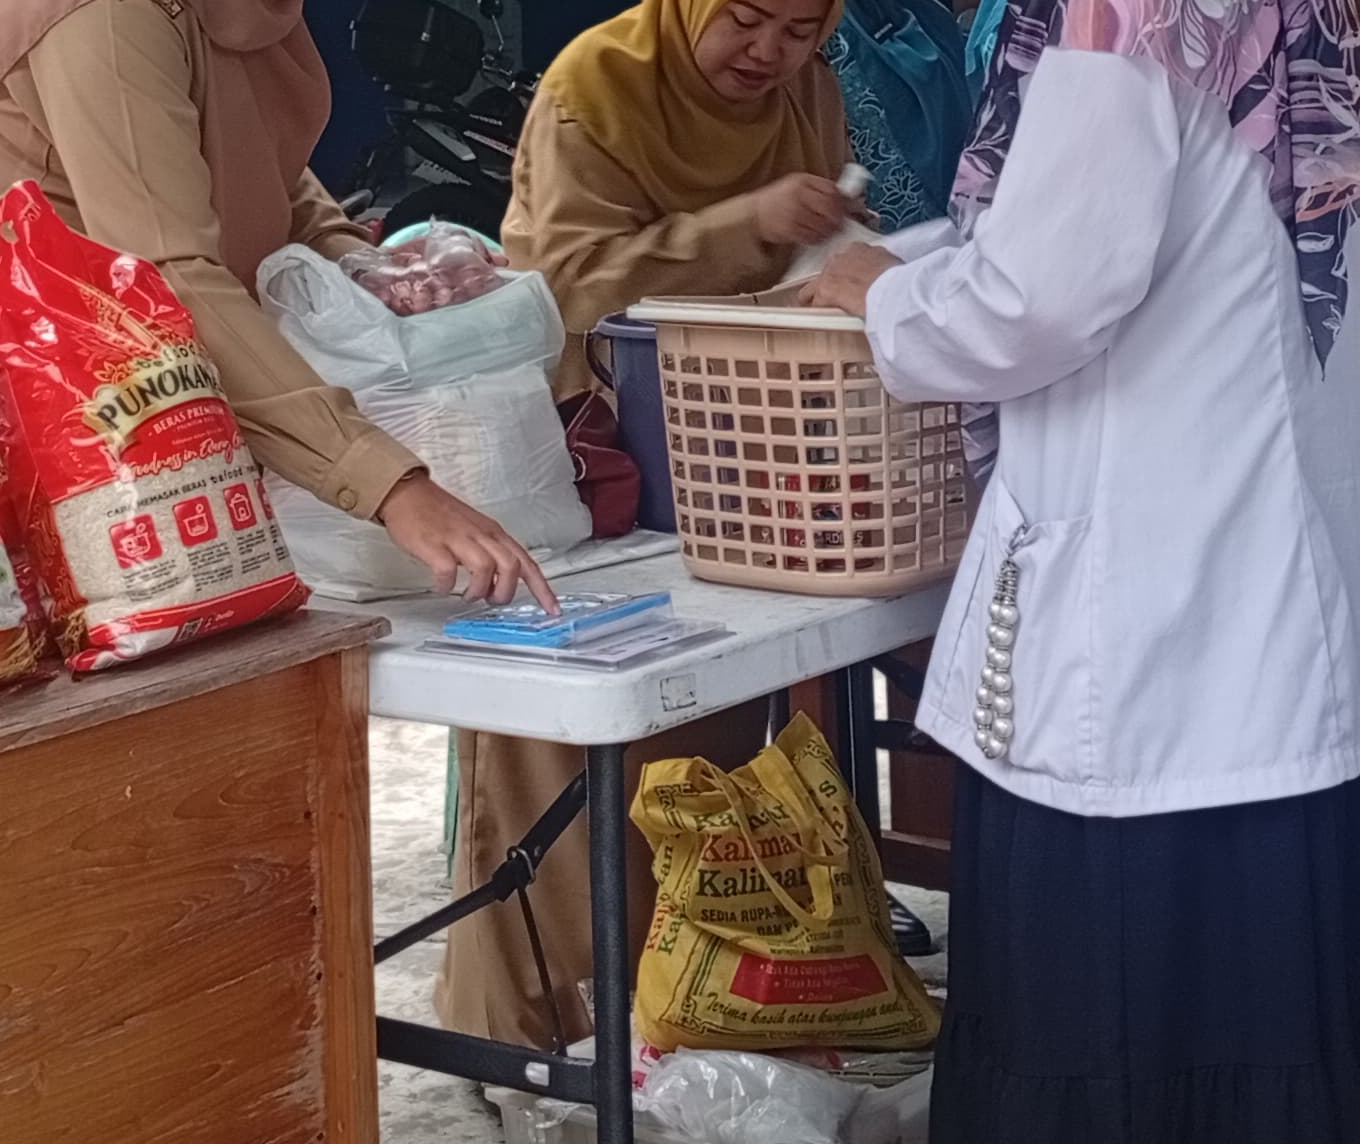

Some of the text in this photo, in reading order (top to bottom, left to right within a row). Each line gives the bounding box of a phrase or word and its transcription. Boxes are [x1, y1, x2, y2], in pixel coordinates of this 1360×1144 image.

[152, 411, 186, 436] BERAS
[700, 908, 738, 923] SEDIA
[706, 991, 748, 1021] Terima
[750, 1008, 785, 1025] kasih
[787, 1011, 815, 1025] atas
